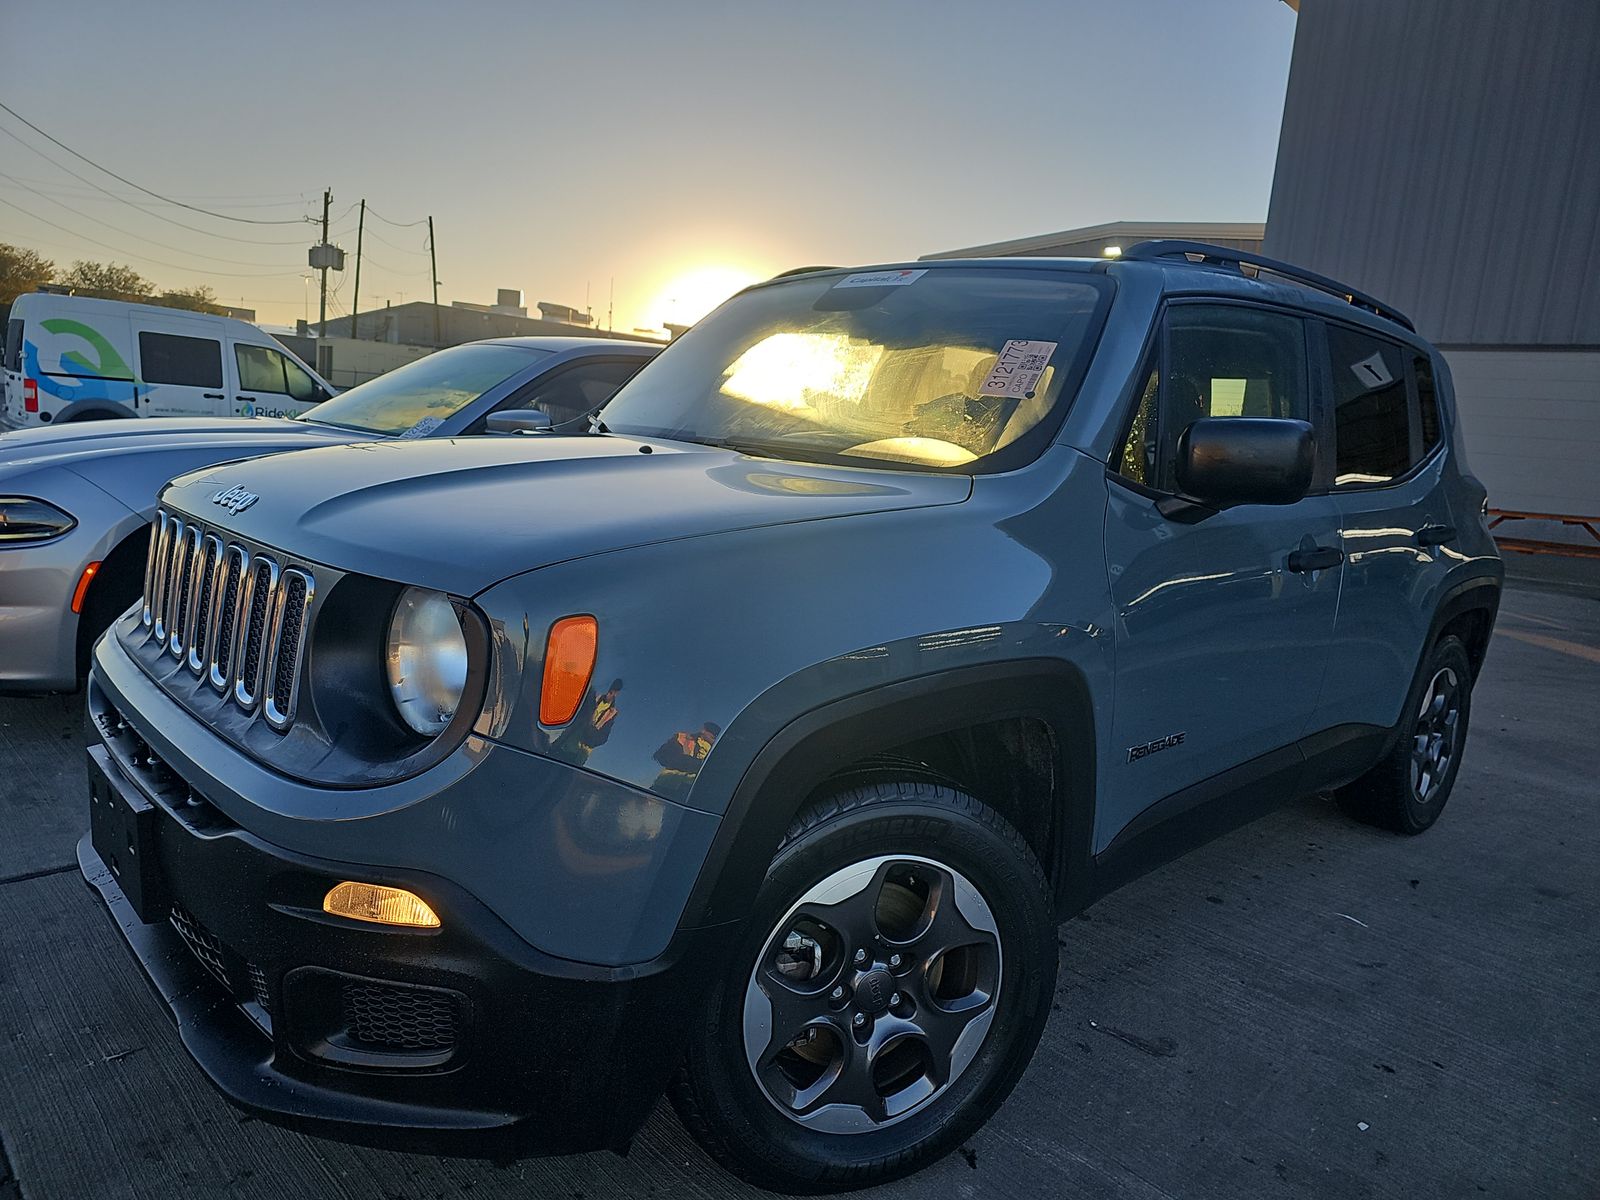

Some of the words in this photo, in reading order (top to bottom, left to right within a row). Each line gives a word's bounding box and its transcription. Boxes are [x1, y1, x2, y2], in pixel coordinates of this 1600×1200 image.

[988, 340, 1028, 389] 3121773
[1012, 373, 1027, 393] CAPO
[212, 484, 260, 517] Jeep
